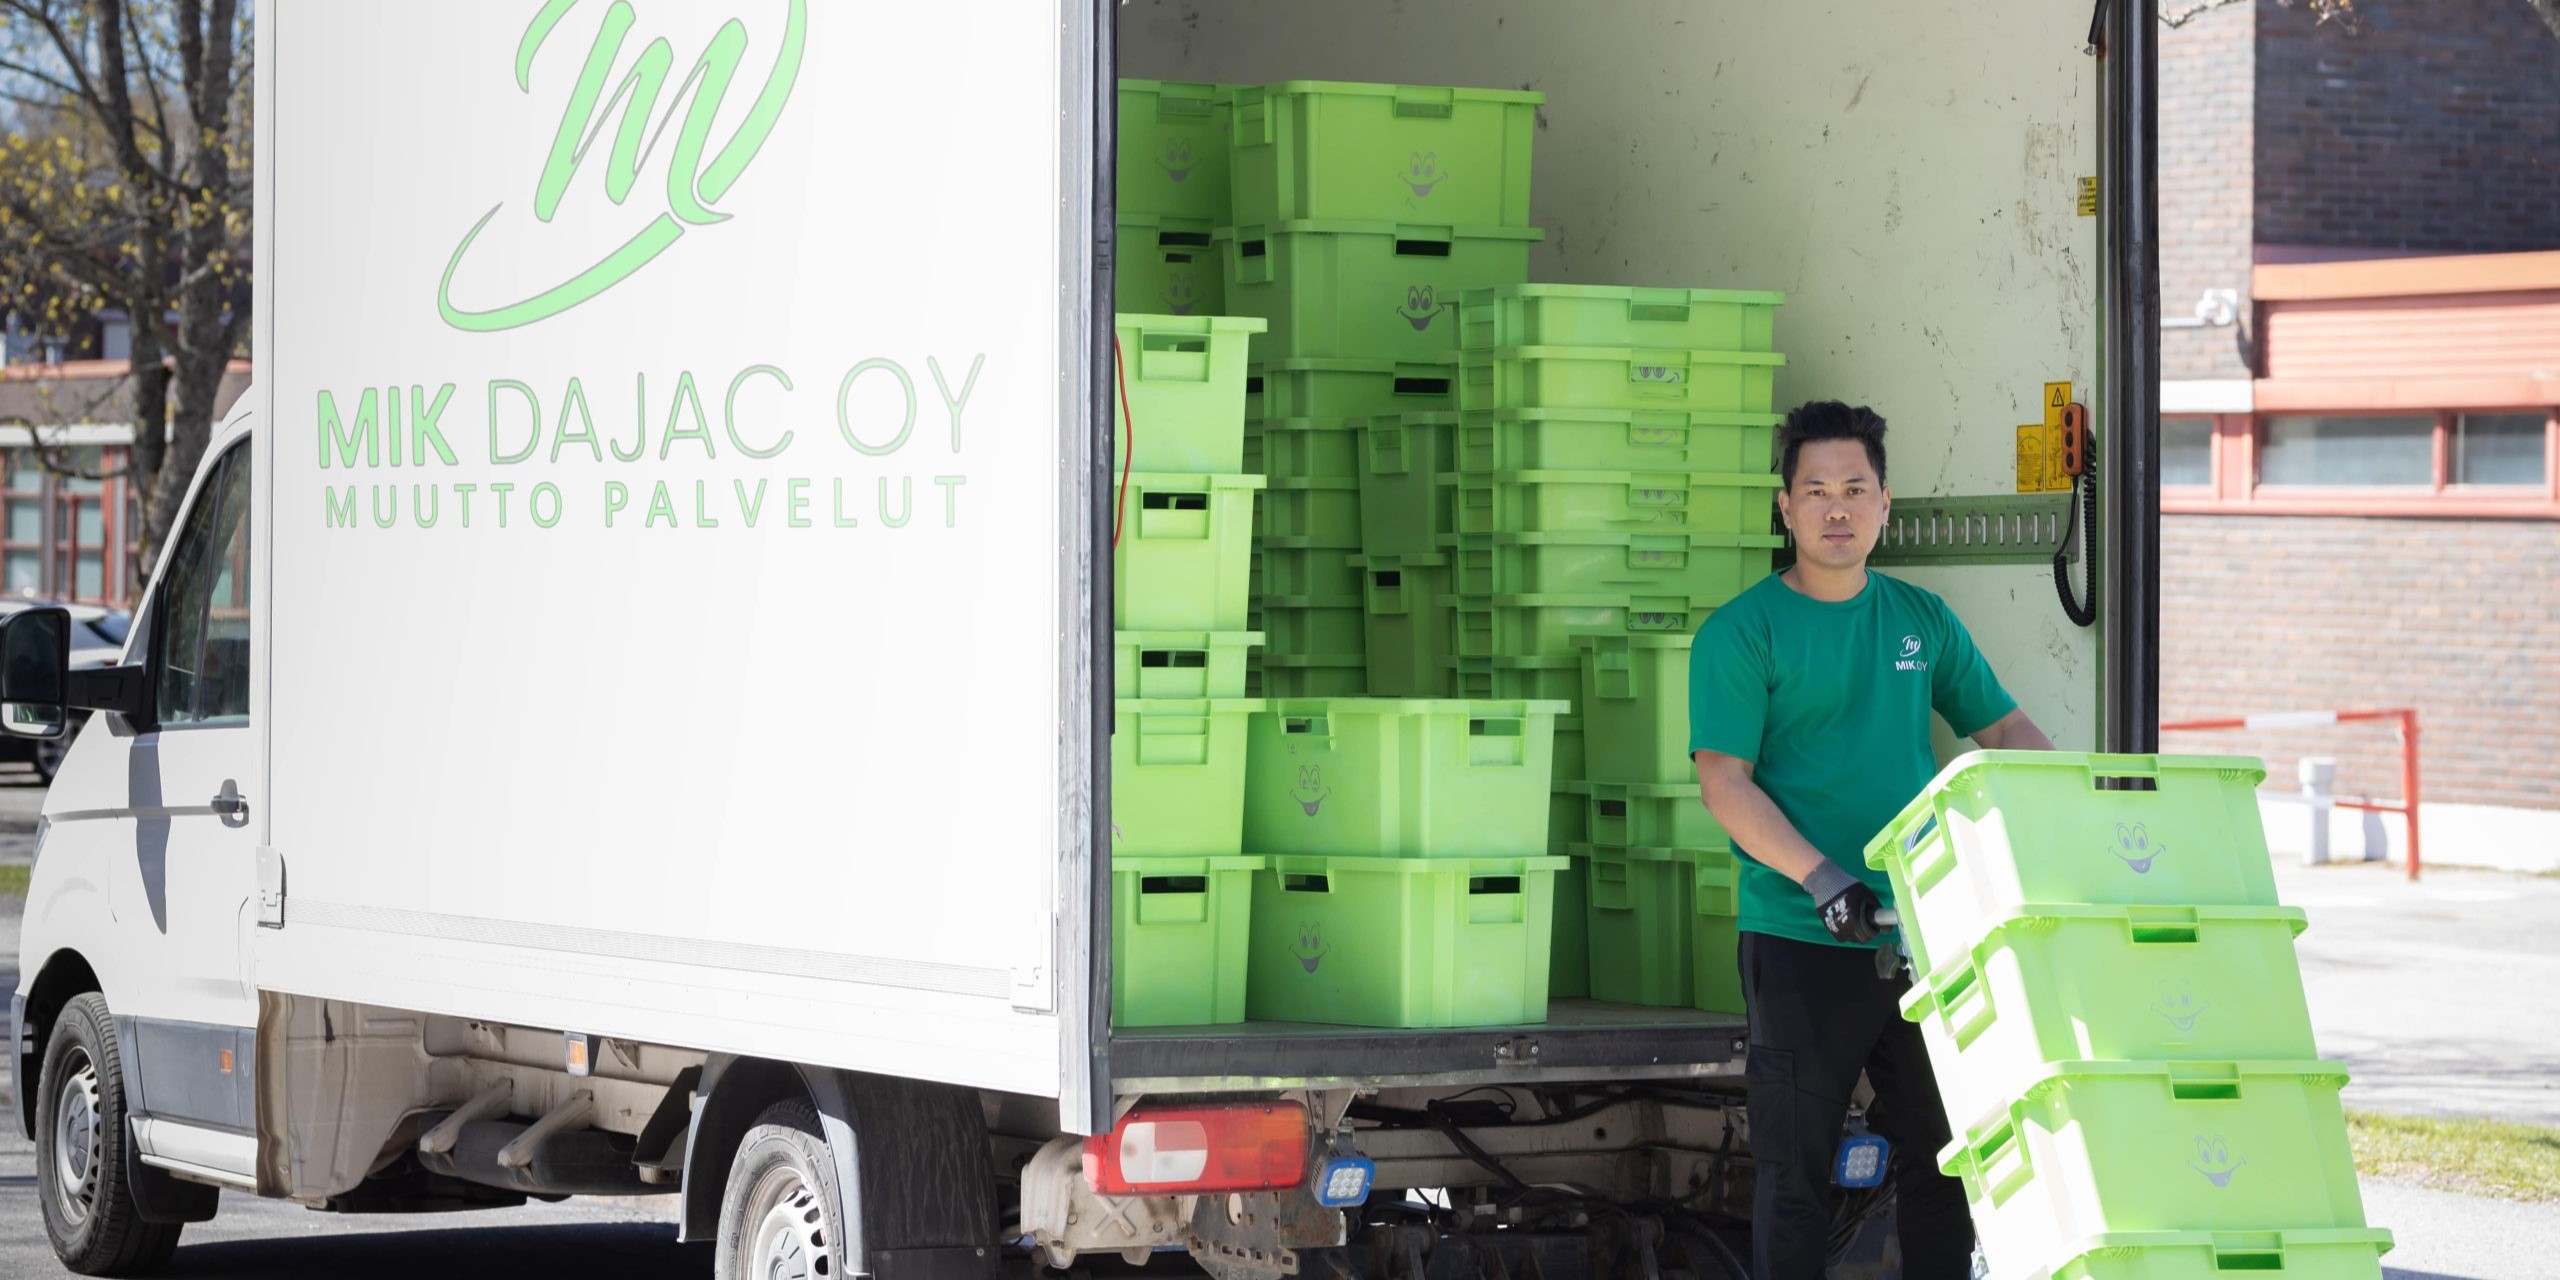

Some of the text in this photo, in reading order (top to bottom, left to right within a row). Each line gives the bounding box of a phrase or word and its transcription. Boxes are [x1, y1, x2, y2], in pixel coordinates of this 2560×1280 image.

[316, 353, 986, 470] MIK DAJAC OY
[324, 475, 968, 530] MUUTTO PALVELUT
[1895, 660, 1928, 672] MIK OY
